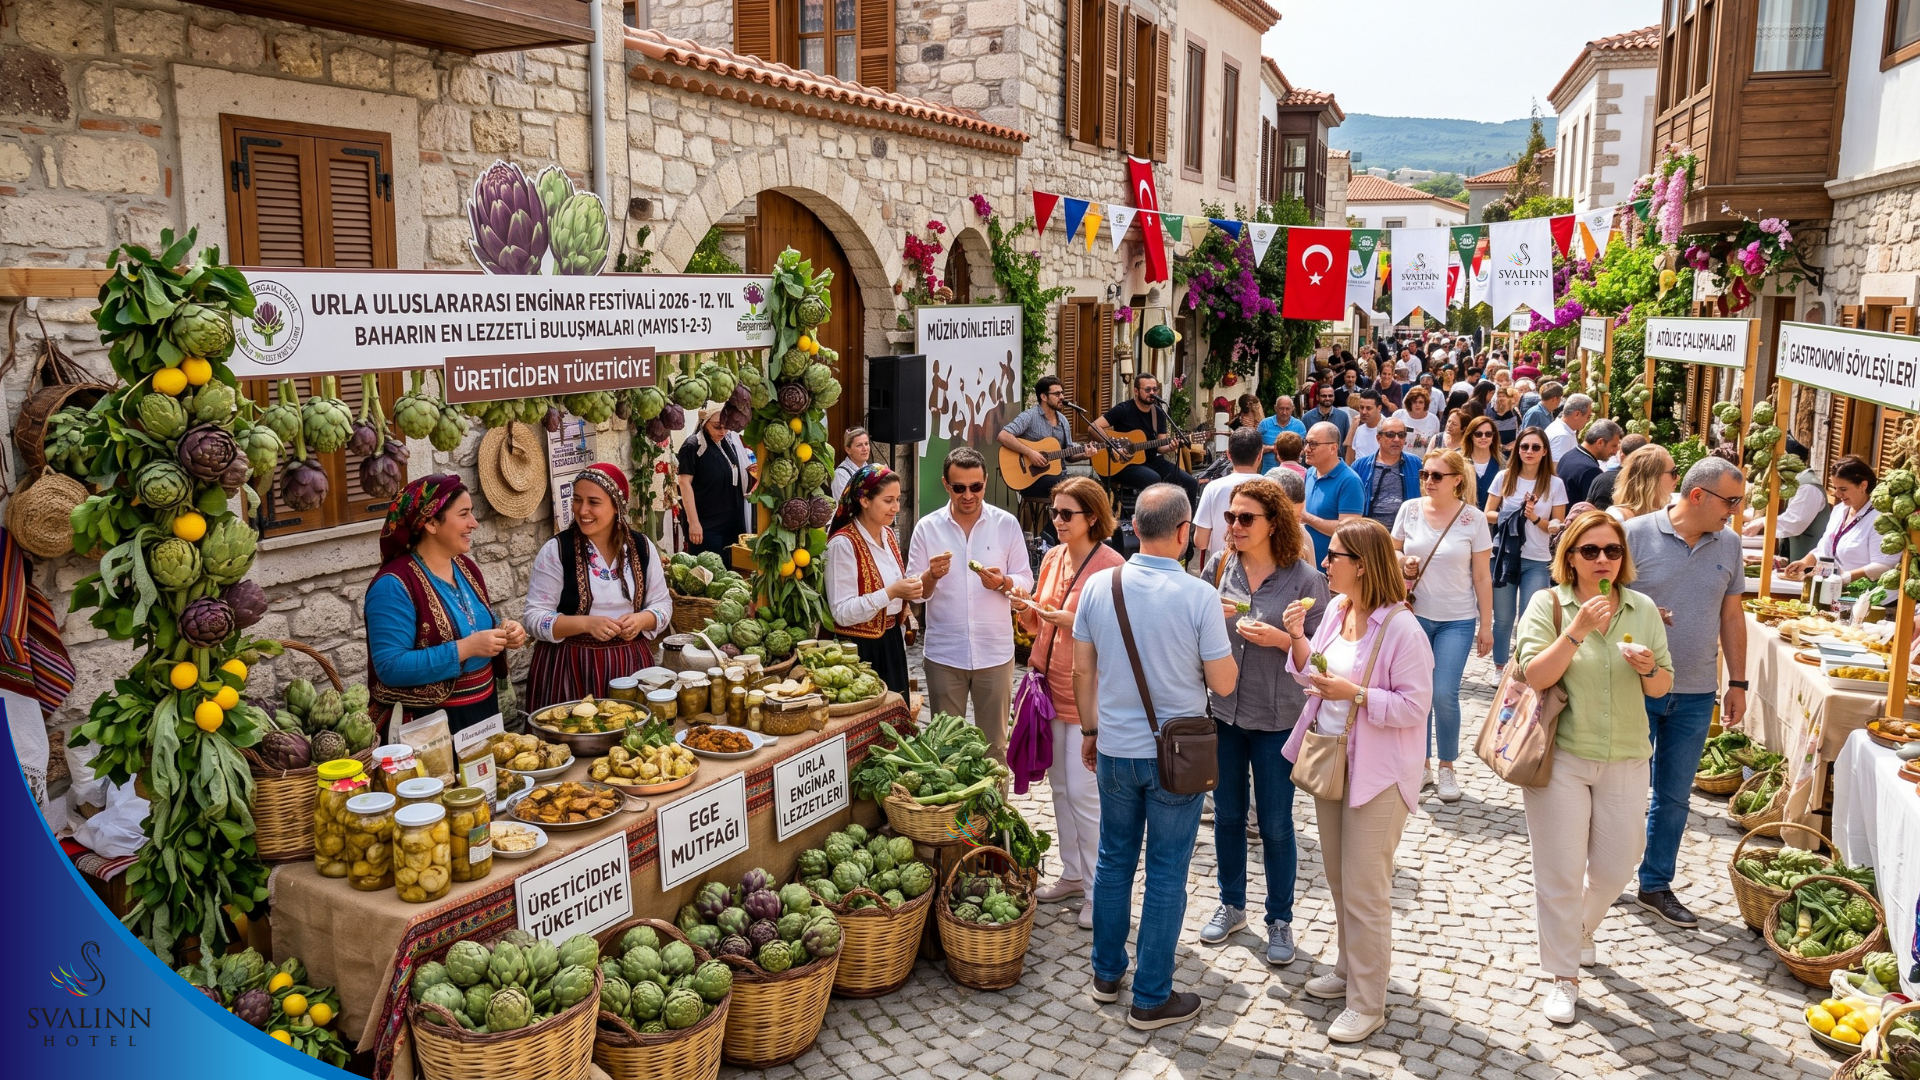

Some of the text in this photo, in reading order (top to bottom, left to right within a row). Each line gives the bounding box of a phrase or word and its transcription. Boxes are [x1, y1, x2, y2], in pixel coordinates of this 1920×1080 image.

[1401, 273, 1439, 281] SVALINN
[1498, 269, 1549, 279] SVALINN
[311, 293, 369, 316] URLA
[373, 292, 511, 315] ULUSLARARASI
[515, 289, 586, 312] ENGİNAR
[589, 288, 656, 311] FESTİVALİ
[658, 292, 690, 310] 2026
[699, 292, 715, 309] 12.
[716, 292, 735, 309] YIL
[354, 324, 436, 347] BAHARIN
[440, 323, 463, 343] EN
[467, 317, 536, 342] LEZZETLİ
[540, 318, 634, 341] BULUŞMALARI
[637, 317, 679, 338] (MAYIS
[680, 317, 712, 335] 1-2-3)
[927, 315, 1014, 341] MÜZİK DİNLETİLERİ
[1682, 332, 1736, 353] ÇALIŞMALARI
[454, 355, 651, 392] ÜRETİCİDEN TÜKETİCİYE
[1790, 343, 1918, 389] GASTRONOMİ SÖYLEŞİLERİ
[797, 754, 826, 779] URLA
[790, 768, 836, 802] ENGİNAR
[689, 801, 720, 832] EGE
[782, 781, 844, 827] LEZZETLERİ
[671, 818, 740, 868] MUTFAĞI
[528, 857, 622, 916] ÜRETİCİDEN
[531, 882, 623, 941] TÜKETİCİYE
